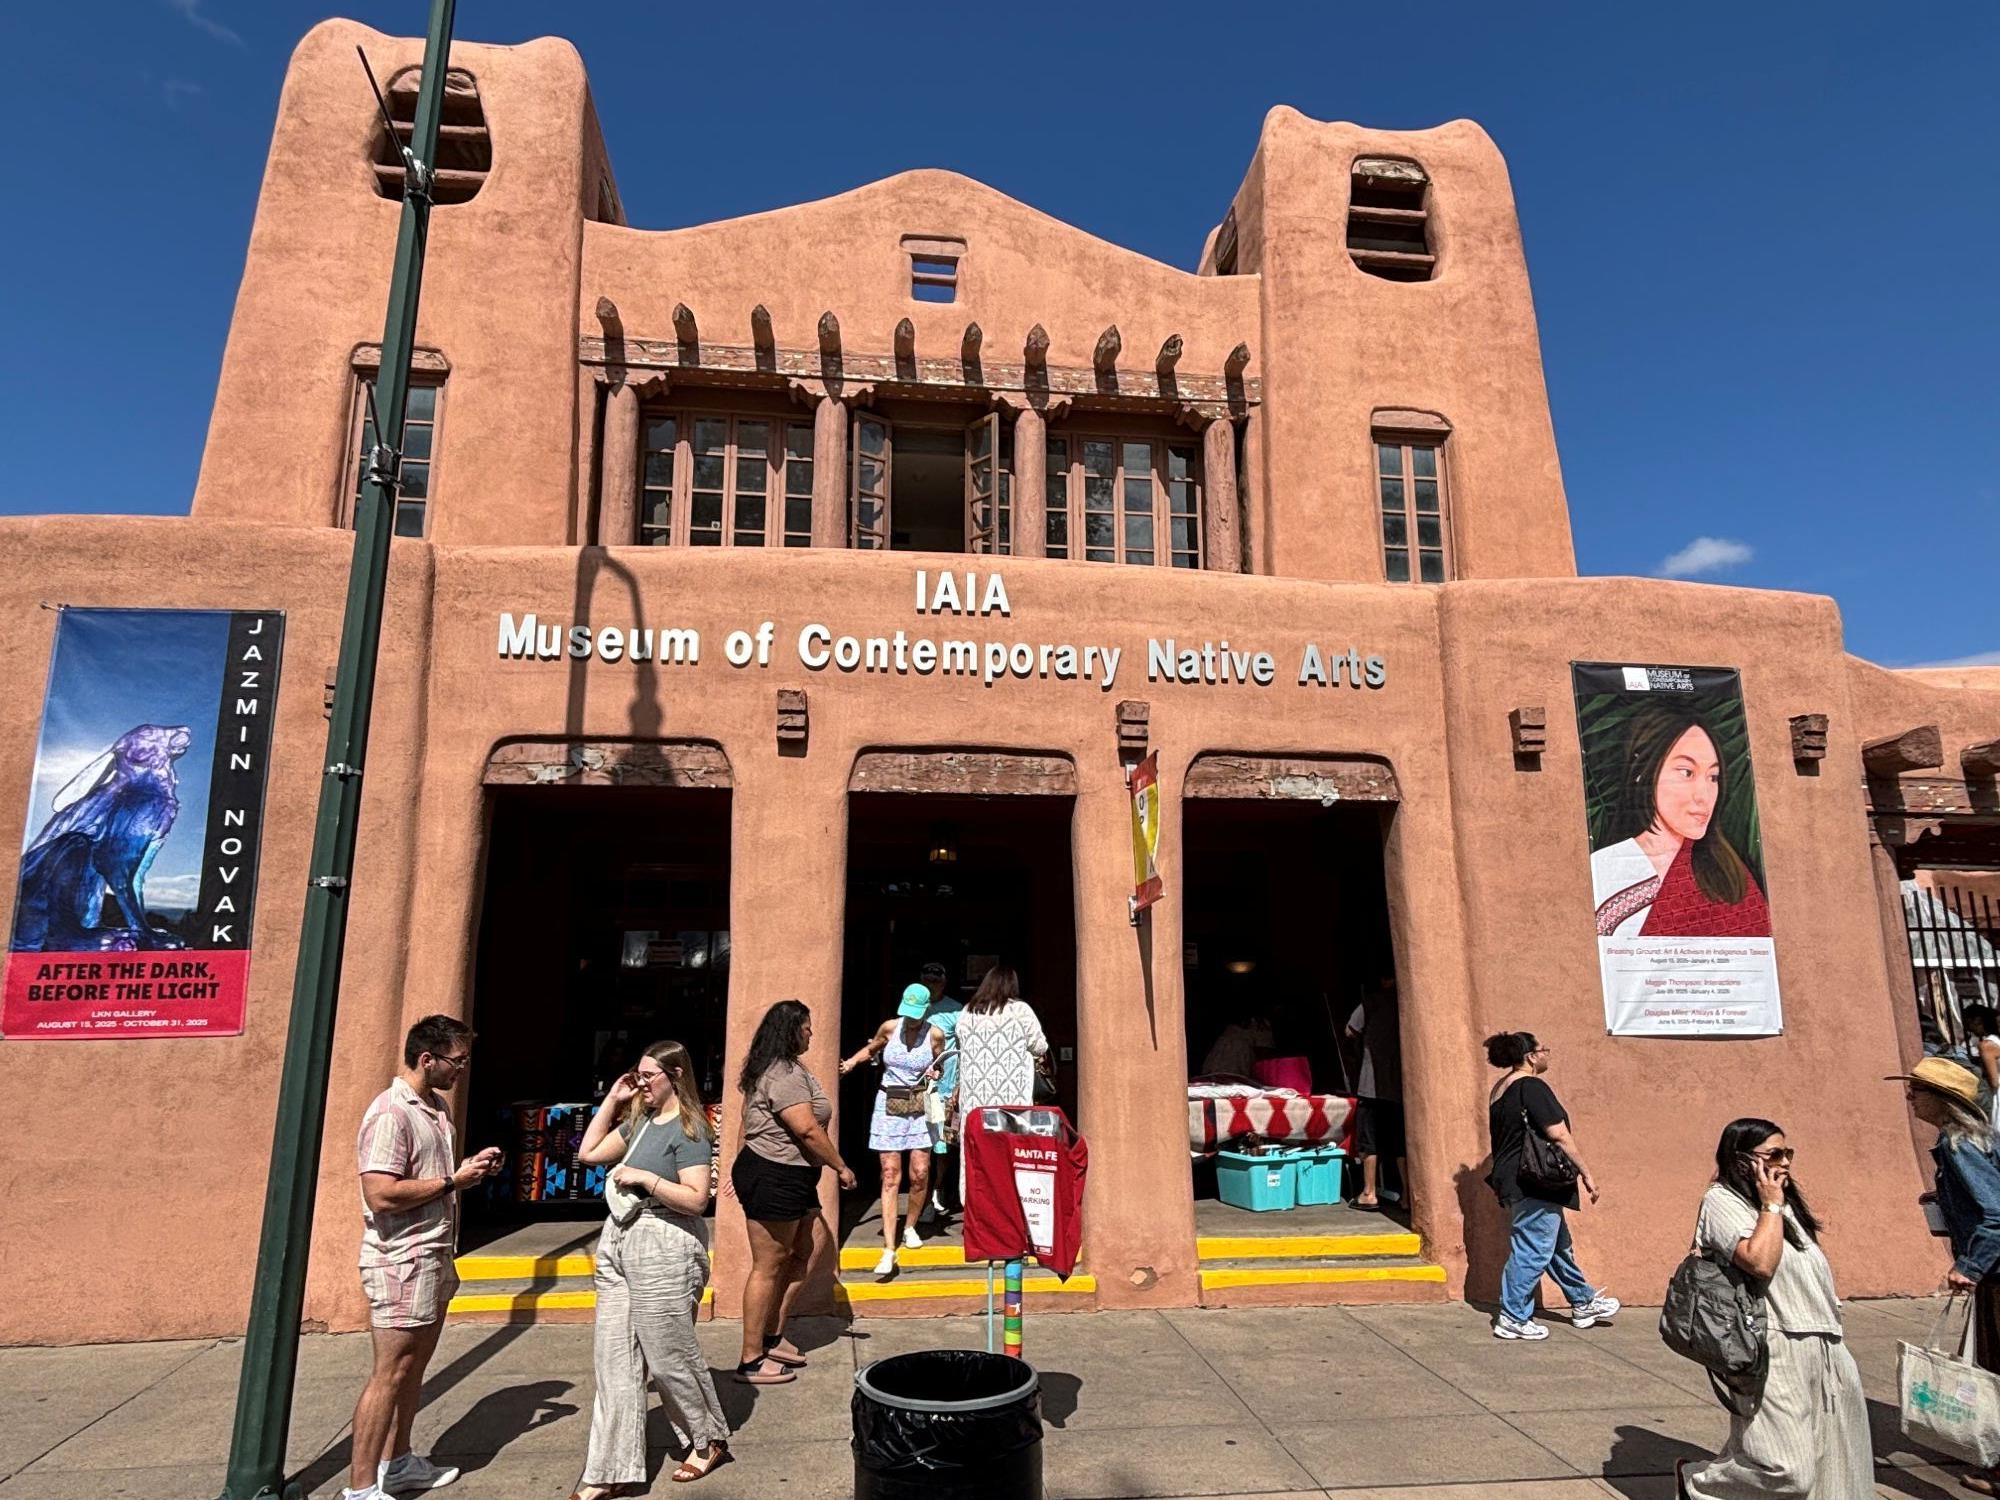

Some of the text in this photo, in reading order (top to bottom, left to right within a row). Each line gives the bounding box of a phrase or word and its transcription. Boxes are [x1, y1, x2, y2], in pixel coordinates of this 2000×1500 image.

[915, 570, 1011, 616] IAIA
[498, 612, 1387, 690] Museum of Contemporary Native Arts
[1647, 670, 1682, 679] MUSEUM
[1650, 682, 1694, 691] NATIVE ARTS
[230, 618, 264, 772] JAZMIN
[211, 808, 245, 943] NOVAK
[1713, 949, 1748, 957] Indigenous
[36, 962, 216, 981] AFTER THE DARK,
[28, 982, 220, 1001] BEFORE THE LIGHT
[37, 1021, 77, 1029] AUGUST
[94, 1020, 117, 1028] 2025
[1014, 1147, 1058, 1162] SANTA FE
[1030, 1187, 1041, 1195] NO
[1019, 1196, 1050, 1206] PARKING
